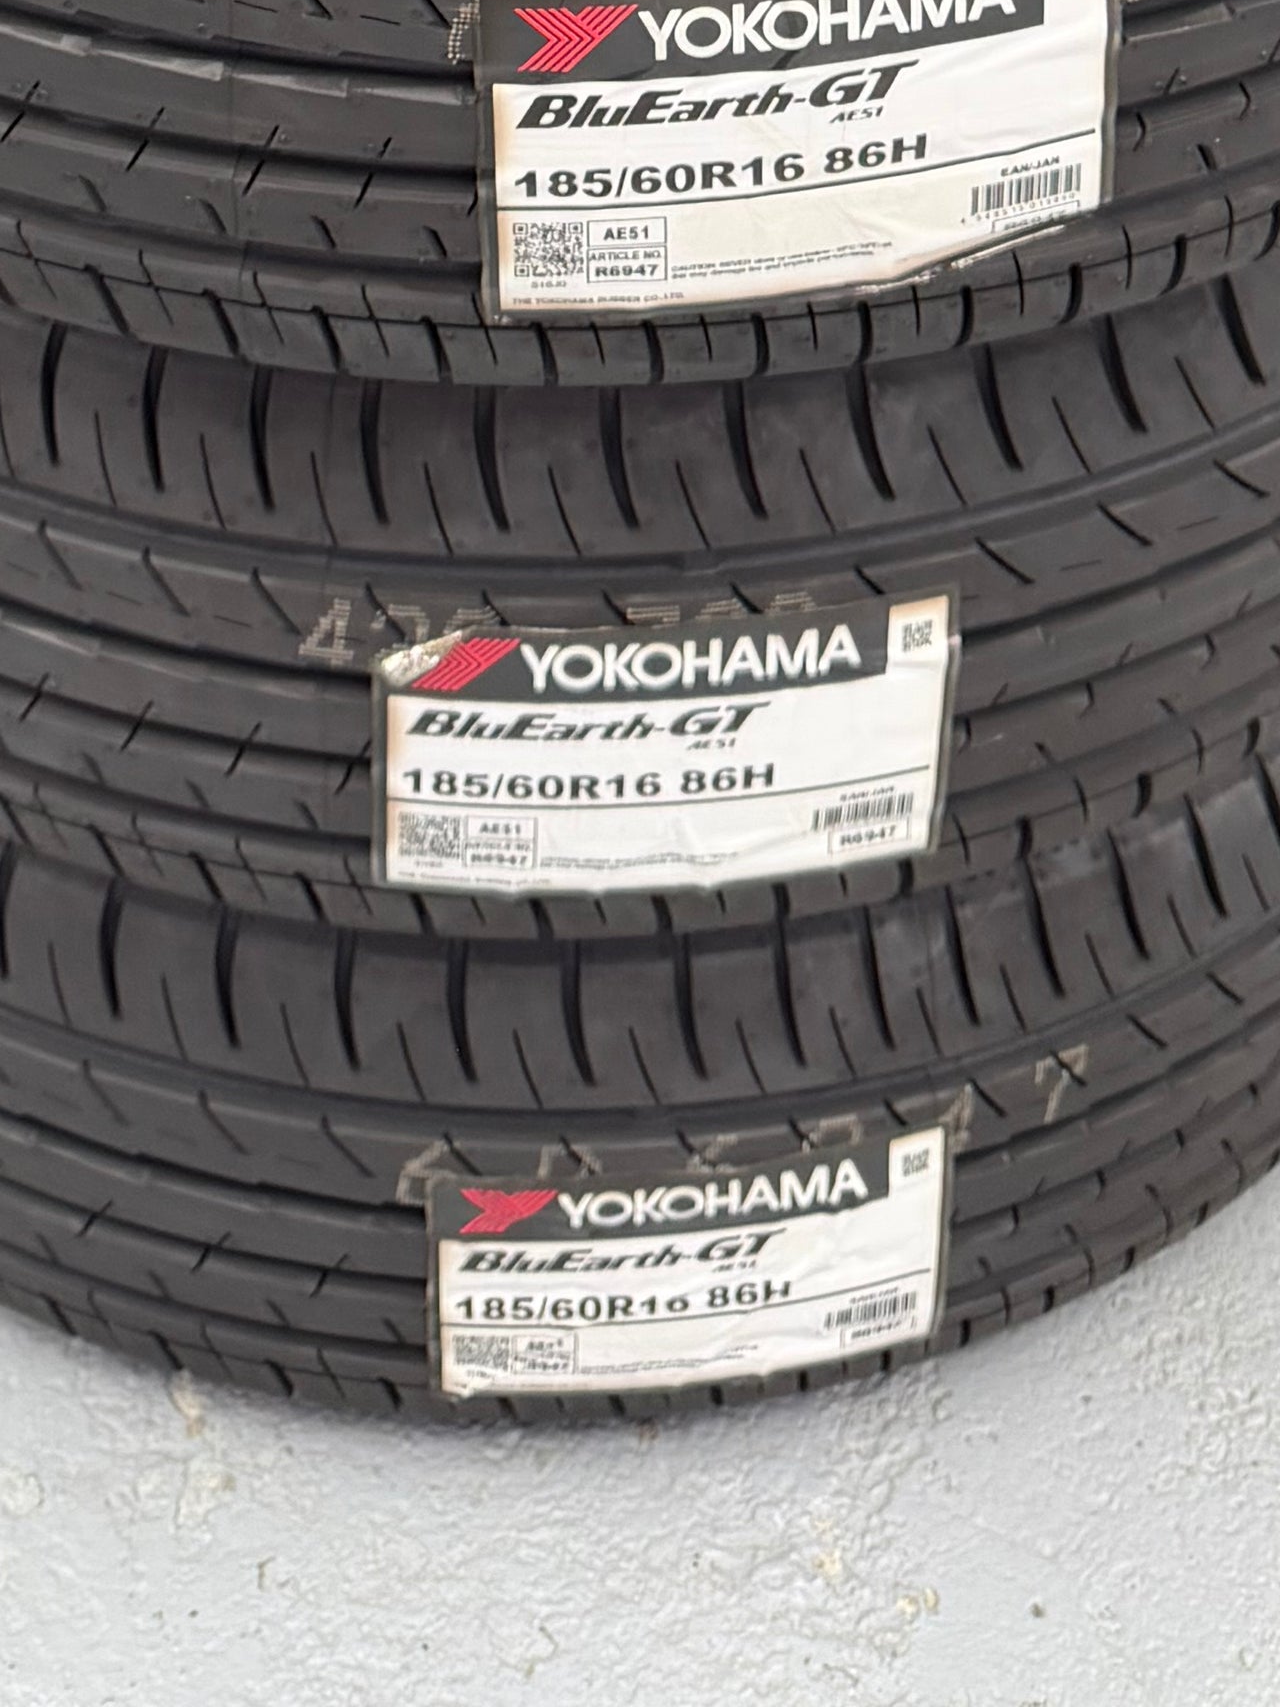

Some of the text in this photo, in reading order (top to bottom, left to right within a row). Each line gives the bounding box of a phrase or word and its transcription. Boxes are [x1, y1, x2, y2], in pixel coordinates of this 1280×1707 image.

[515, 59, 921, 130] BluEarth-GT
[829, 106, 884, 125] AE51
[513, 134, 928, 200] 185/60R16 86H
[603, 225, 650, 241] AE51
[594, 263, 660, 278] R6947
[521, 623, 863, 694] YOKOHAMA
[406, 700, 772, 742] BluEarth-GT
[402, 761, 776, 801] 185/60R16 86H
[558, 1158, 869, 1230] YOKOHAMA
[458, 1227, 786, 1273] BluEarth-GT
[706, 1279, 792, 1307] 86H
